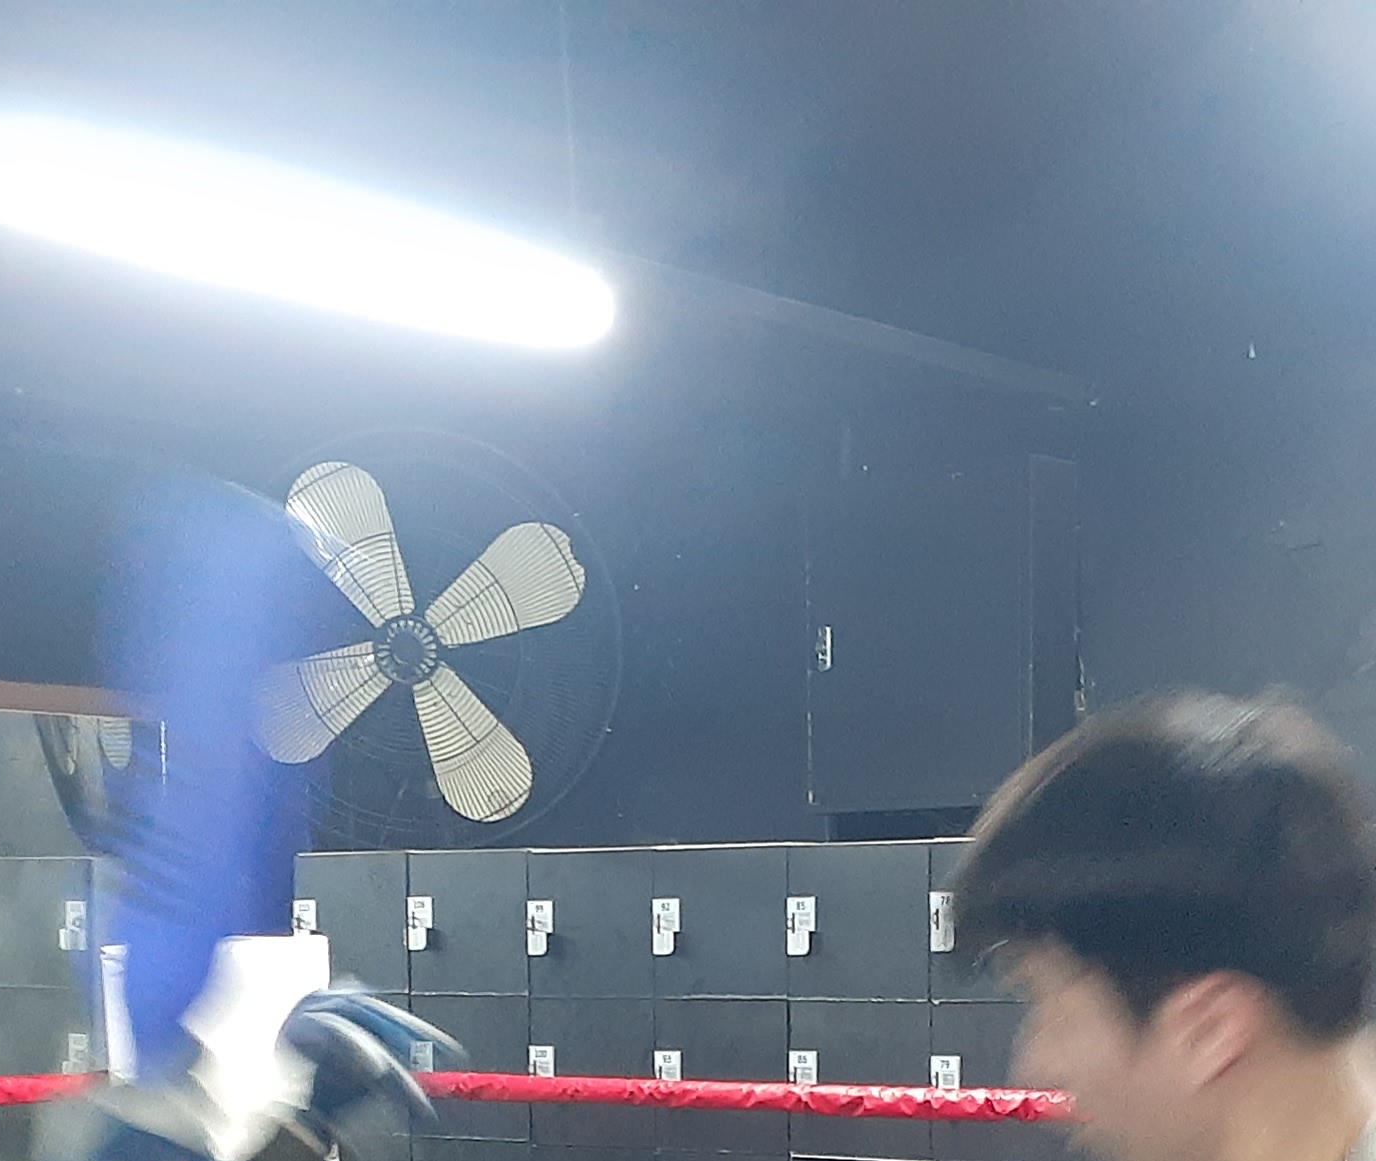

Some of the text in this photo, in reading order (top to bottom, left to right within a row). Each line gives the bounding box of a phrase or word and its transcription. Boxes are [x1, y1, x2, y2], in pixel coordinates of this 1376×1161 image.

[660, 902, 671, 911] 92
[796, 901, 806, 910] 85
[797, 1054, 808, 1064] 86
[940, 1060, 951, 1069] 79
